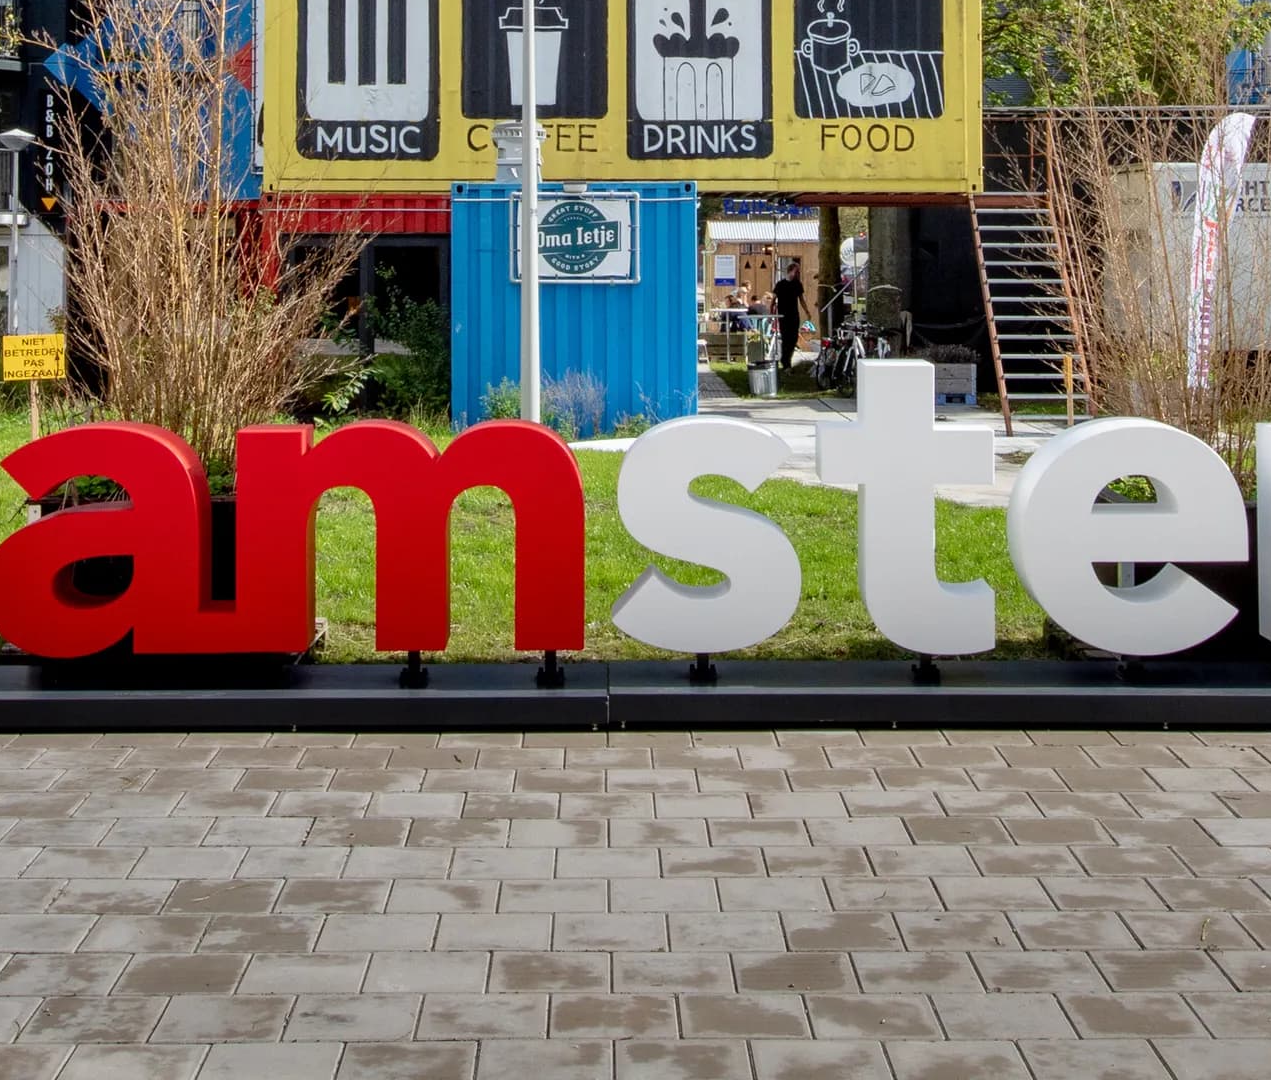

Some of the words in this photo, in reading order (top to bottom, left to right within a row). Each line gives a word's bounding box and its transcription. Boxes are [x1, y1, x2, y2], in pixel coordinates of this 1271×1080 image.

[316, 124, 421, 154] MUSIC
[467, 123, 598, 153] CEE
[643, 123, 758, 154] DRINKS
[821, 124, 915, 152] FOOD
[538, 231, 572, 248] Oma
[576, 225, 615, 249] Ietje
[4, 347, 64, 358] BETREDEN
[21, 337, 46, 346] NIET
[4, 369, 64, 378] INGEZAAID
[23, 359, 45, 367] PAS
